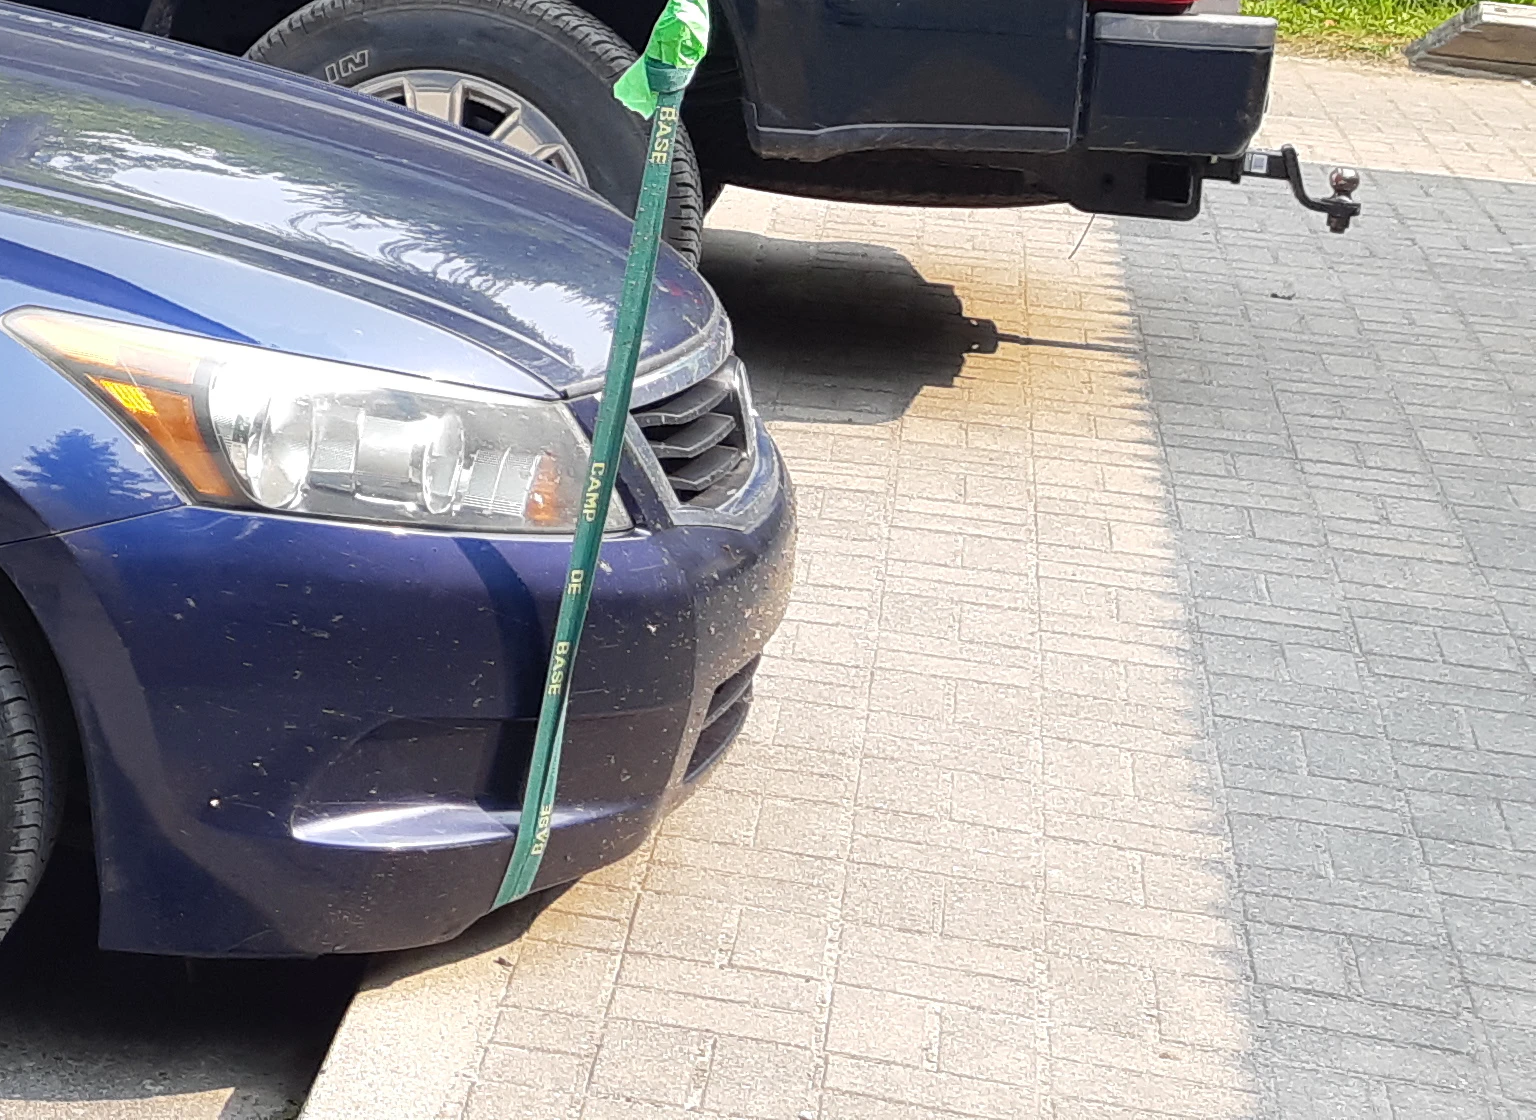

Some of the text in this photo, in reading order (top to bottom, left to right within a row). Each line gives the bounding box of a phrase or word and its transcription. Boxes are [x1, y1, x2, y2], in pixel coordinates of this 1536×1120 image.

[651, 106, 678, 165] BASE
[548, 462, 606, 695] CAMP DE BASE
[530, 803, 550, 856] BASE
